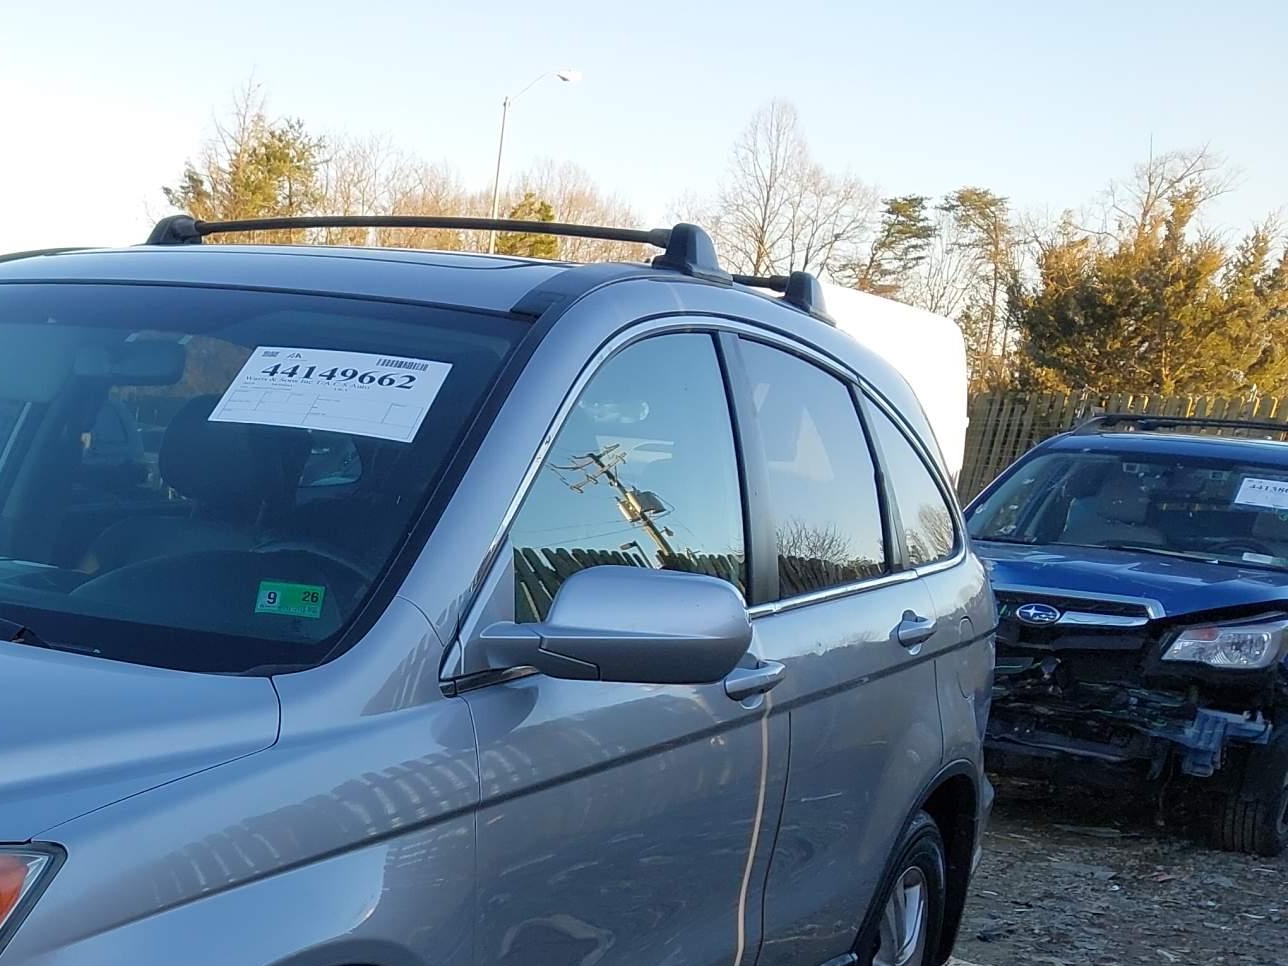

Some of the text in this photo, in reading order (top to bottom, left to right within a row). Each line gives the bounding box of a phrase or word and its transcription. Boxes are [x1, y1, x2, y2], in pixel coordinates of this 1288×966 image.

[261, 363, 417, 390] 44149662
[266, 591, 278, 605] 9
[302, 591, 320, 604] 26
